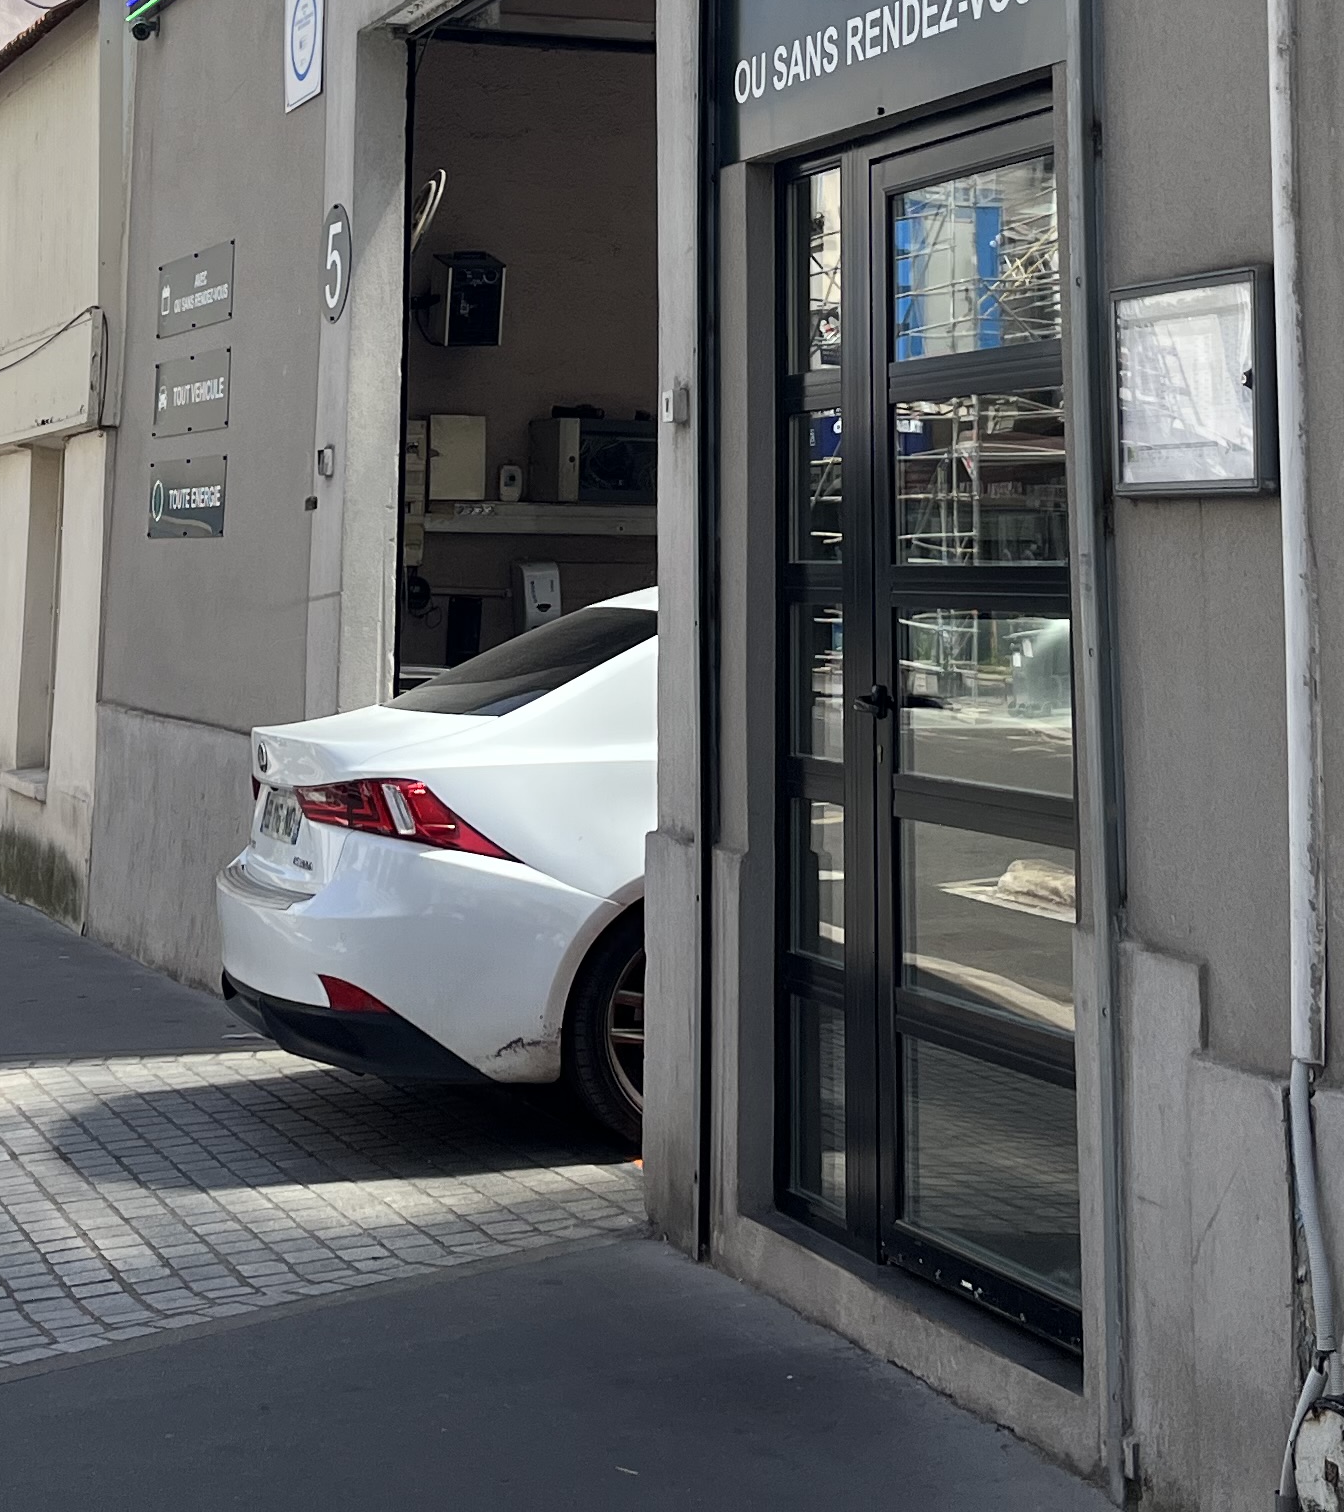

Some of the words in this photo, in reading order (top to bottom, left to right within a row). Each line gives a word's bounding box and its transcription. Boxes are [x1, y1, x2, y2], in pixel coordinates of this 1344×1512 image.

[734, 52, 766, 104] OU
[772, 26, 838, 91] SANS
[324, 222, 343, 309] 5
